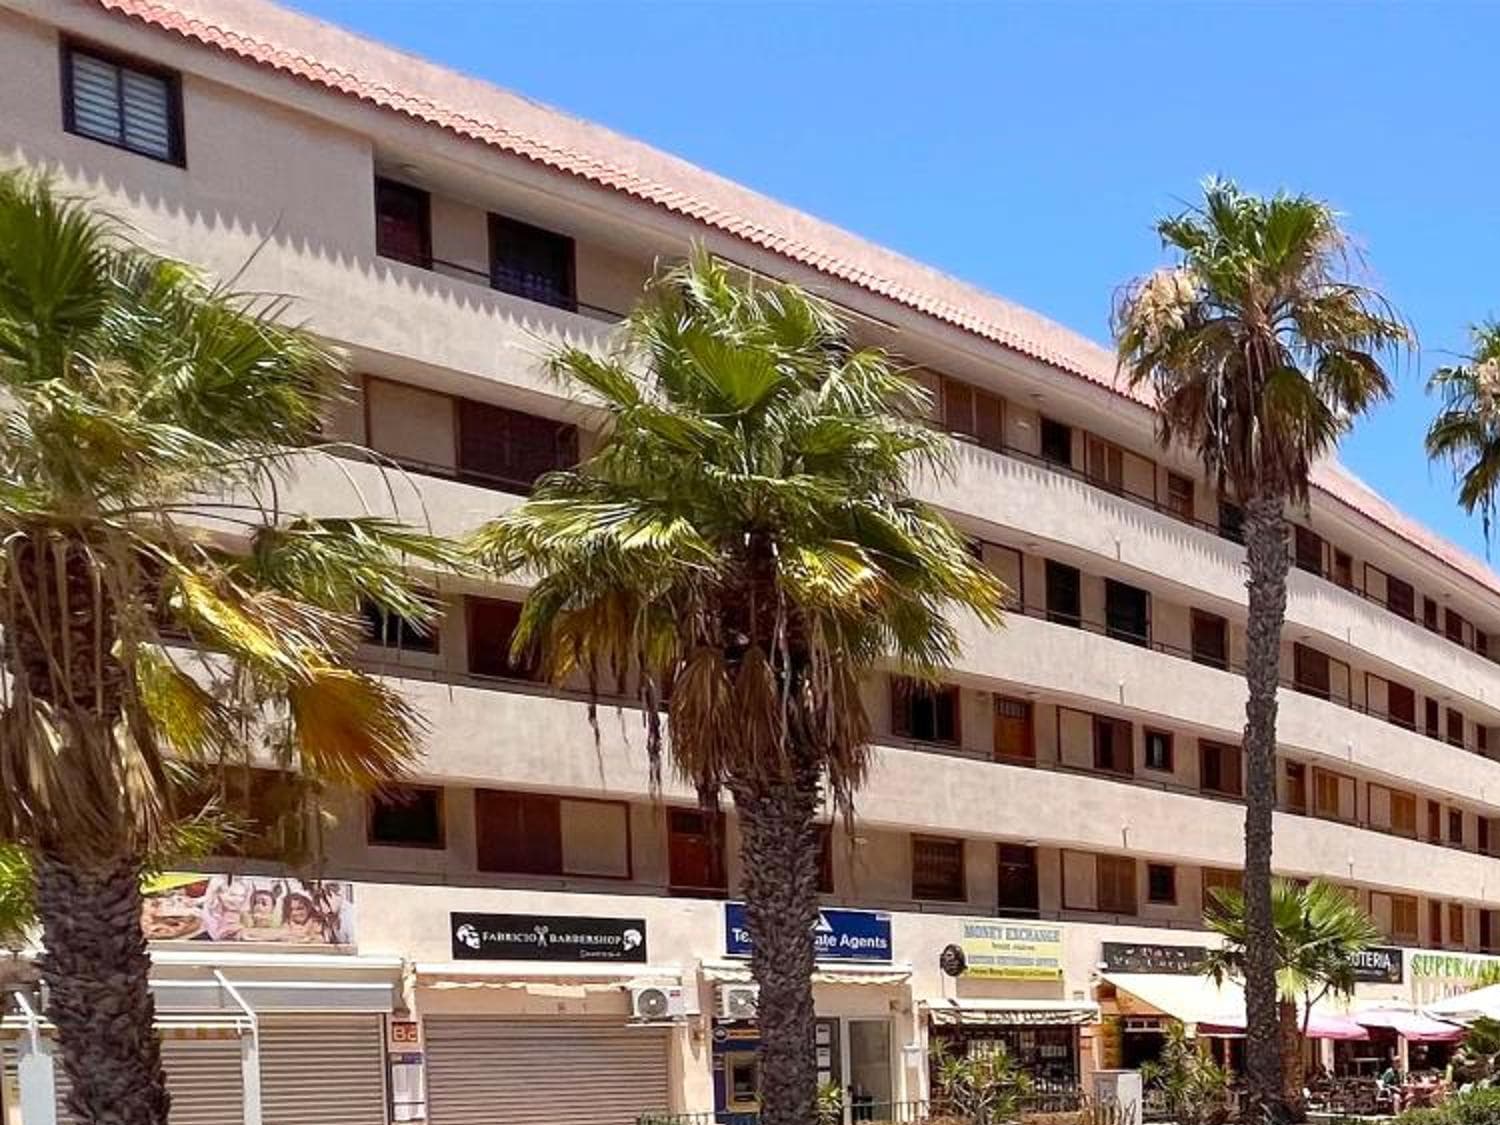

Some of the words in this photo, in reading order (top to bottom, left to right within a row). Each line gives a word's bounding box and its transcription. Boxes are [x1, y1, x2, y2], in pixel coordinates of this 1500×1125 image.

[482, 932, 537, 943] FABRICIO
[549, 933, 622, 945] BARBERSHOP
[964, 925, 1003, 938] MONEY
[1005, 927, 1060, 942] EXCHANGE
[839, 934, 888, 949] Agents
